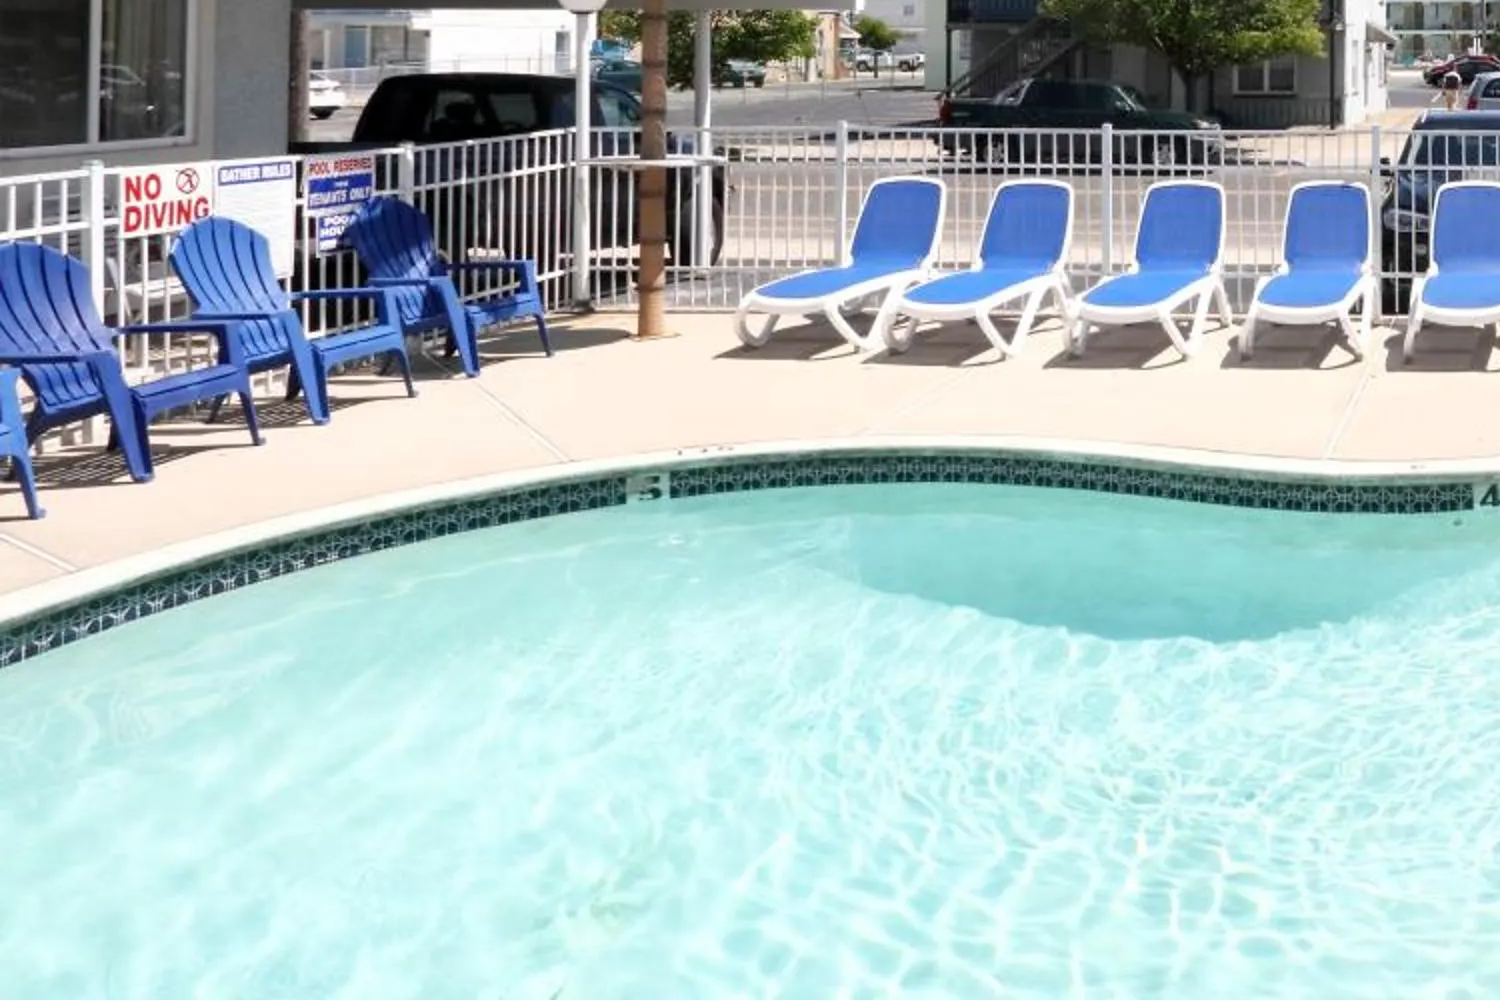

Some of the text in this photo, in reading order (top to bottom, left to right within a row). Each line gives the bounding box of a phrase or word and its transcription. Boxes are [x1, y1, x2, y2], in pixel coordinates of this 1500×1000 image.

[308, 162, 333, 174] POOL
[124, 173, 161, 202] NO
[124, 197, 209, 232] DIVING
[639, 475, 662, 500] 5
